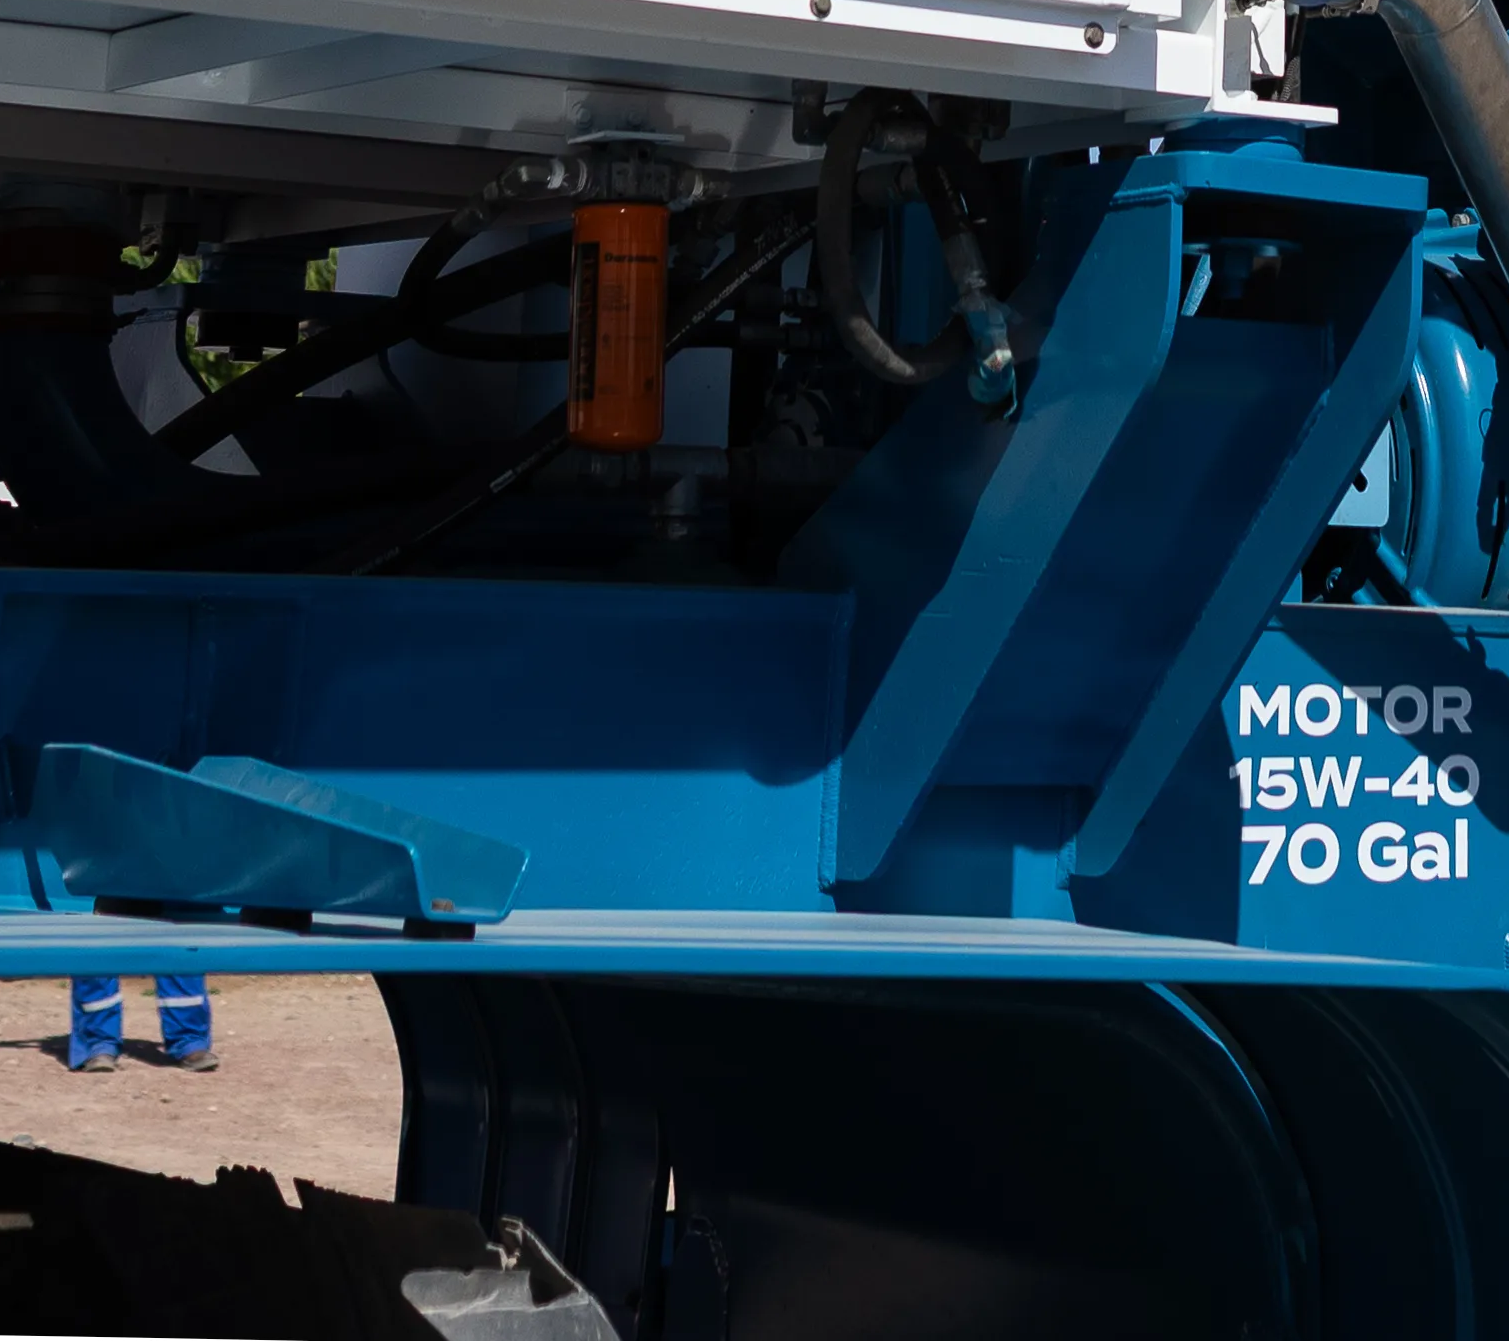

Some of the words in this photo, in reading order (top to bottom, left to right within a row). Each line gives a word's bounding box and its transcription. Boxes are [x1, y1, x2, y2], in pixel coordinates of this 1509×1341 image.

[1238, 683, 1473, 737] MOTOR
[1229, 754, 1480, 811] 15W-40
[1241, 822, 1340, 886] 70
[1357, 818, 1469, 883] Gal
